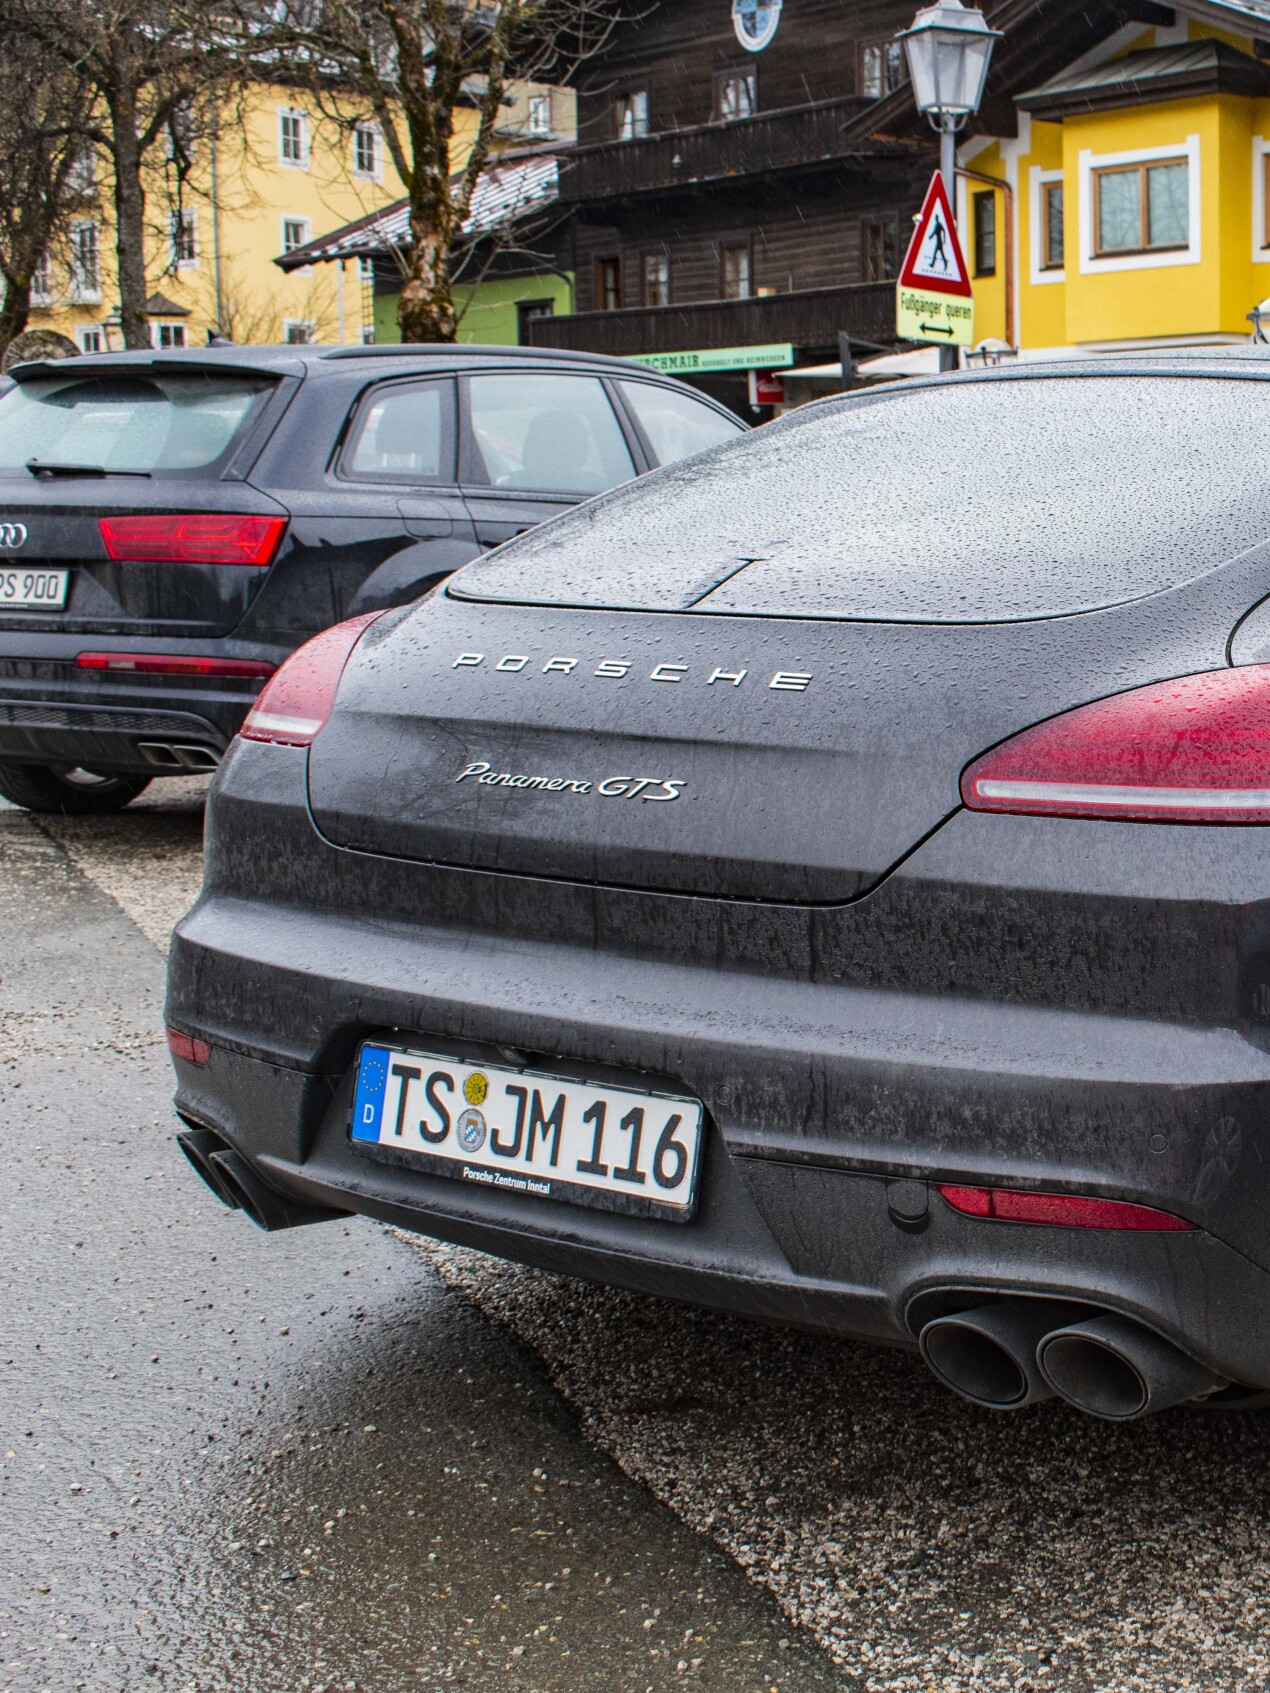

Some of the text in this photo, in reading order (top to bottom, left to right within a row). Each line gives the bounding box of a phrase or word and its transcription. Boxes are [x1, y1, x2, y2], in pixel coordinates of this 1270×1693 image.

[901, 292, 971, 321] Fußgänger queren
[634, 354, 699, 370] RCHMAIR
[23, 574, 59, 599] 900
[452, 652, 813, 691] PORSCHE
[455, 761, 688, 801] Panamera GTS
[362, 1104, 375, 1124] D
[391, 1063, 455, 1144] TS
[490, 1083, 567, 1168] JM
[576, 1100, 689, 1190] 116
[463, 1166, 551, 1195] Porsche Zentrum Inntal
